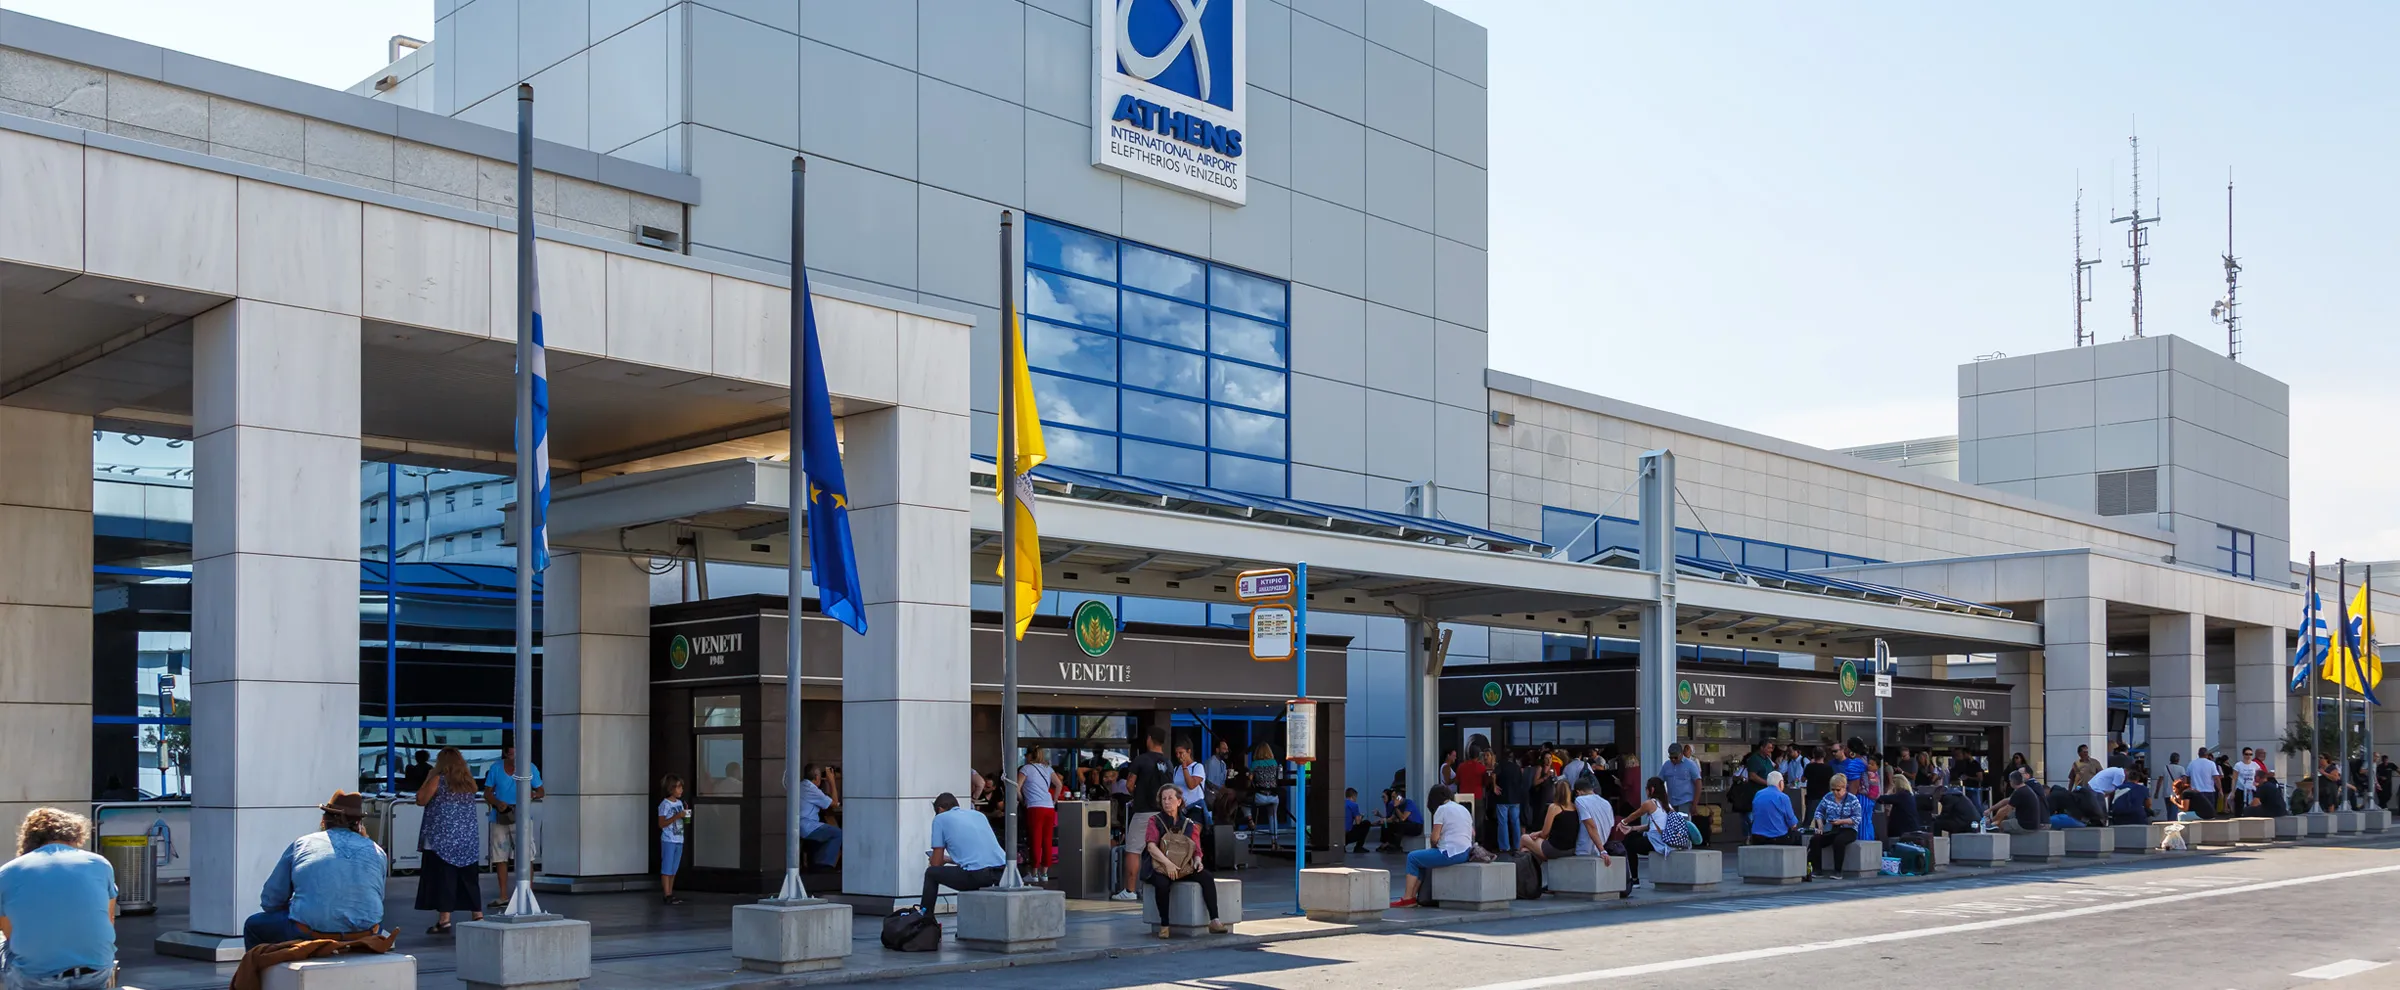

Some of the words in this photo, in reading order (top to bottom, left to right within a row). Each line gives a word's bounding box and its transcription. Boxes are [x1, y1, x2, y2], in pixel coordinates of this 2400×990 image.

[1112, 94, 1242, 158] ATHENS
[1111, 125, 1193, 161] INTERNATIONAL
[1196, 152, 1238, 175] AIRPORT
[1111, 142, 1180, 173] ELEFTHERIOS
[1184, 163, 1238, 190] VENIZELOS
[692, 633, 742, 655] VENETI
[709, 655, 724, 665] 1948
[1059, 662, 1124, 682] VENETI
[1505, 682, 1558, 696] VENETI
[1693, 683, 1725, 697] VENETI
[1834, 700, 1861, 712] VENETI
[1963, 698, 1985, 710] VENETI
